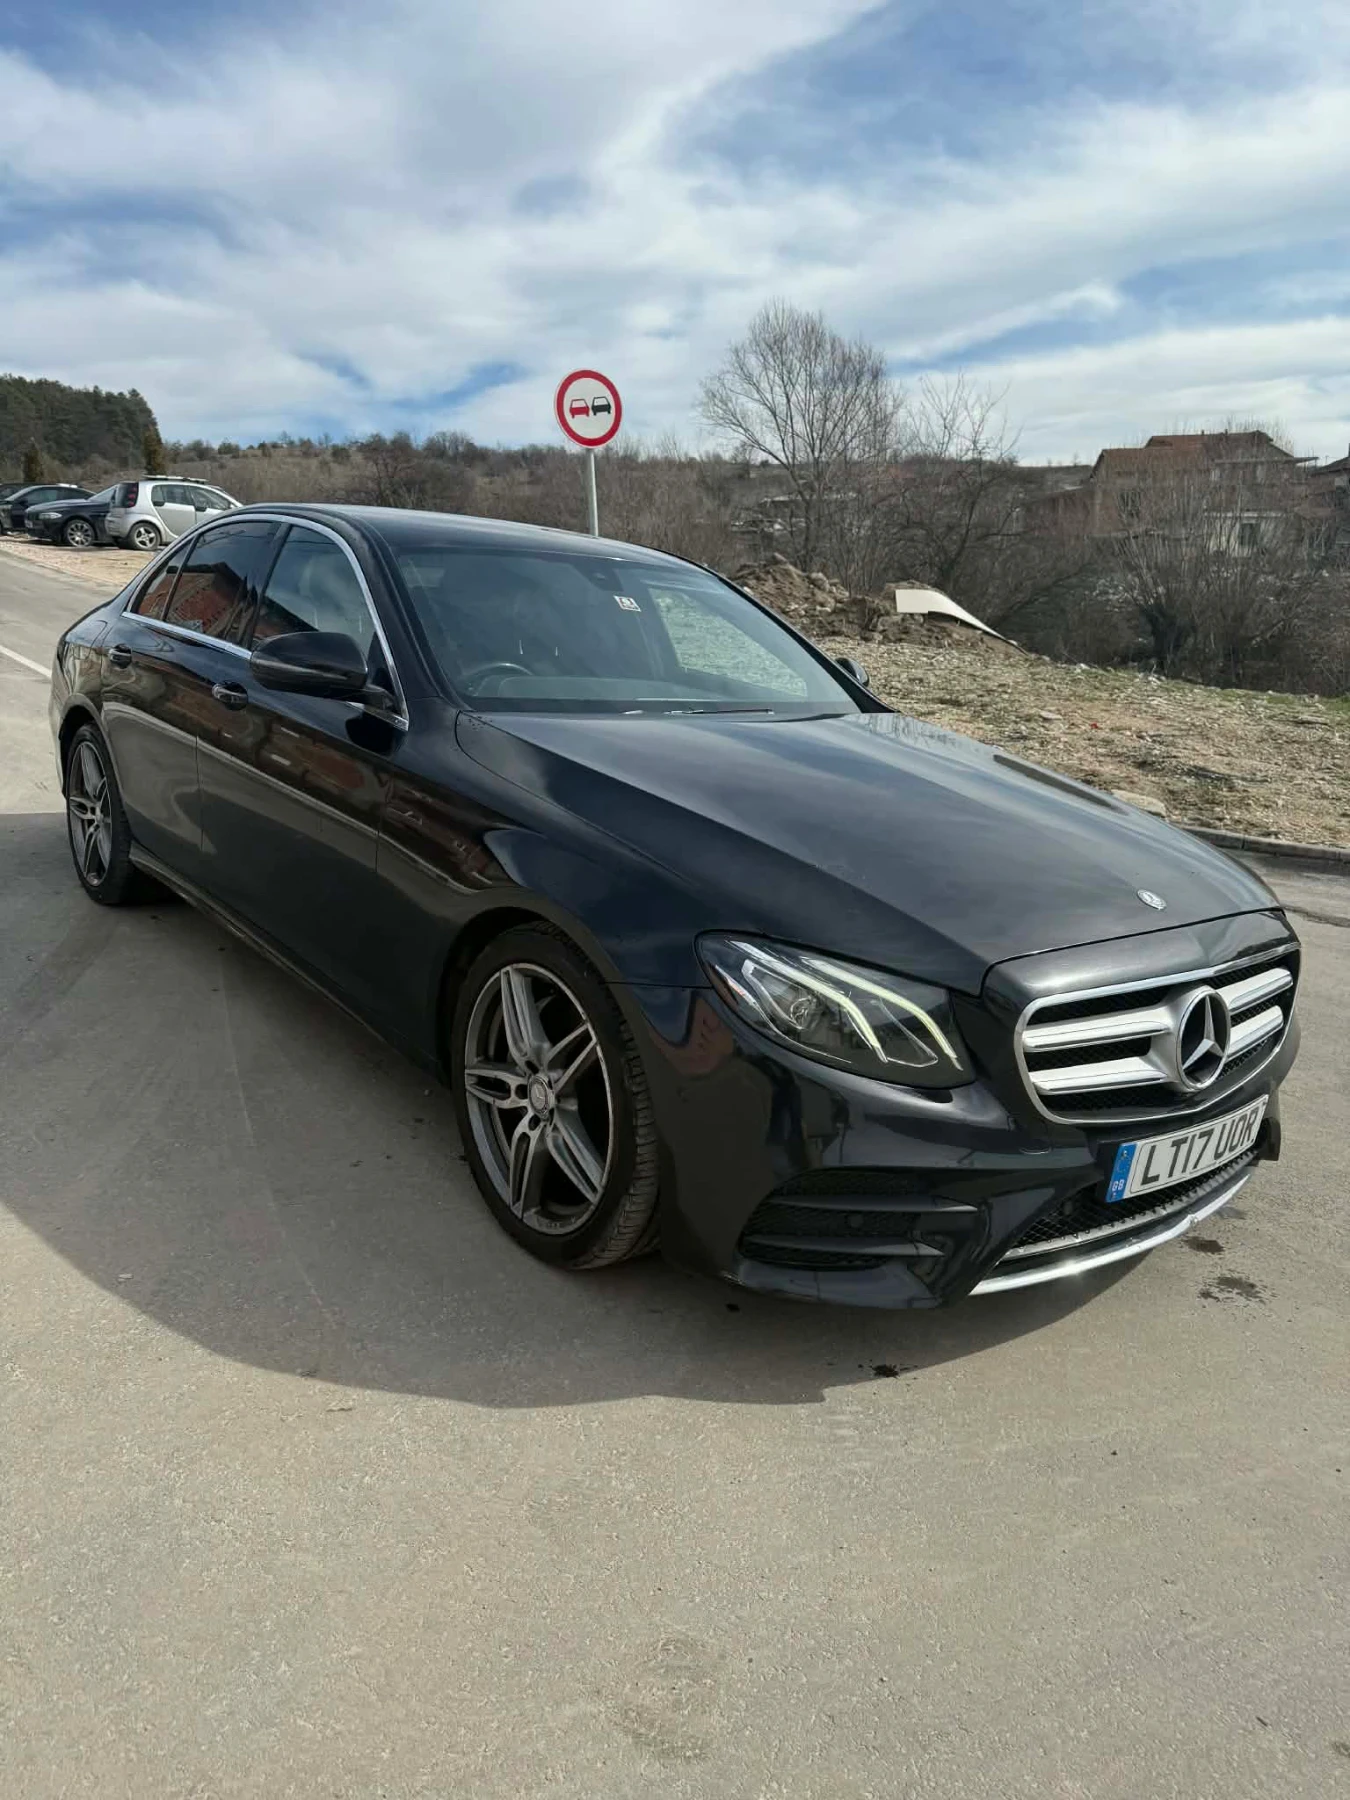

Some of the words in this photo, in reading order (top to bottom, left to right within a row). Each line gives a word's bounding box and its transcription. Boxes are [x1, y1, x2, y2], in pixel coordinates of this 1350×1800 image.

[1140, 1128, 1215, 1186] LT17
[1213, 1105, 1260, 1161] UOR
[1111, 1179, 1125, 1191] GB
